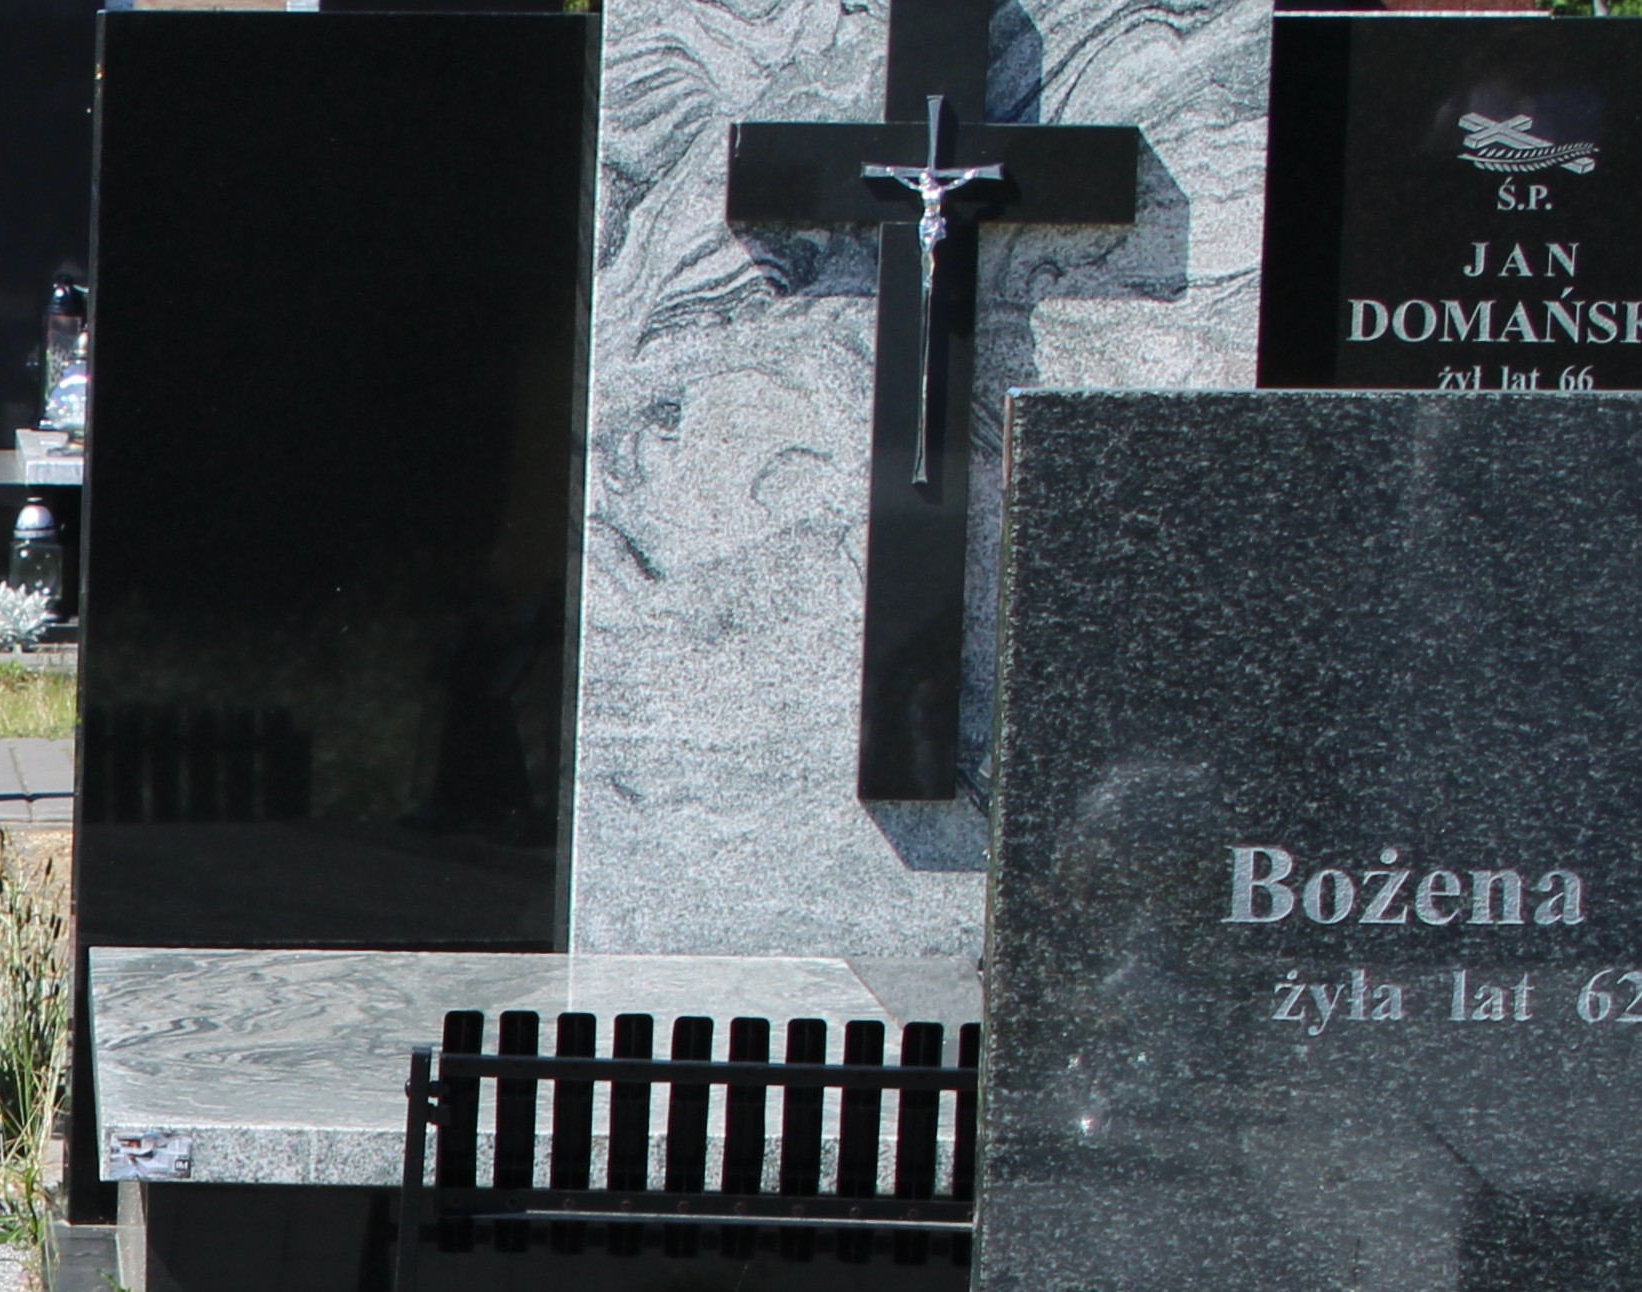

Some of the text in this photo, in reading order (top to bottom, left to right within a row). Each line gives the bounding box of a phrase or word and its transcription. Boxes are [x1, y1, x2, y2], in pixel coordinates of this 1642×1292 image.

[1496, 176, 1553, 211] Ś.P.
[1463, 241, 1580, 277] JAN
[1438, 365, 1594, 390] żył lat 66
[1220, 845, 1586, 926] Bożena
[1271, 968, 1642, 1036] żyła lat 62
